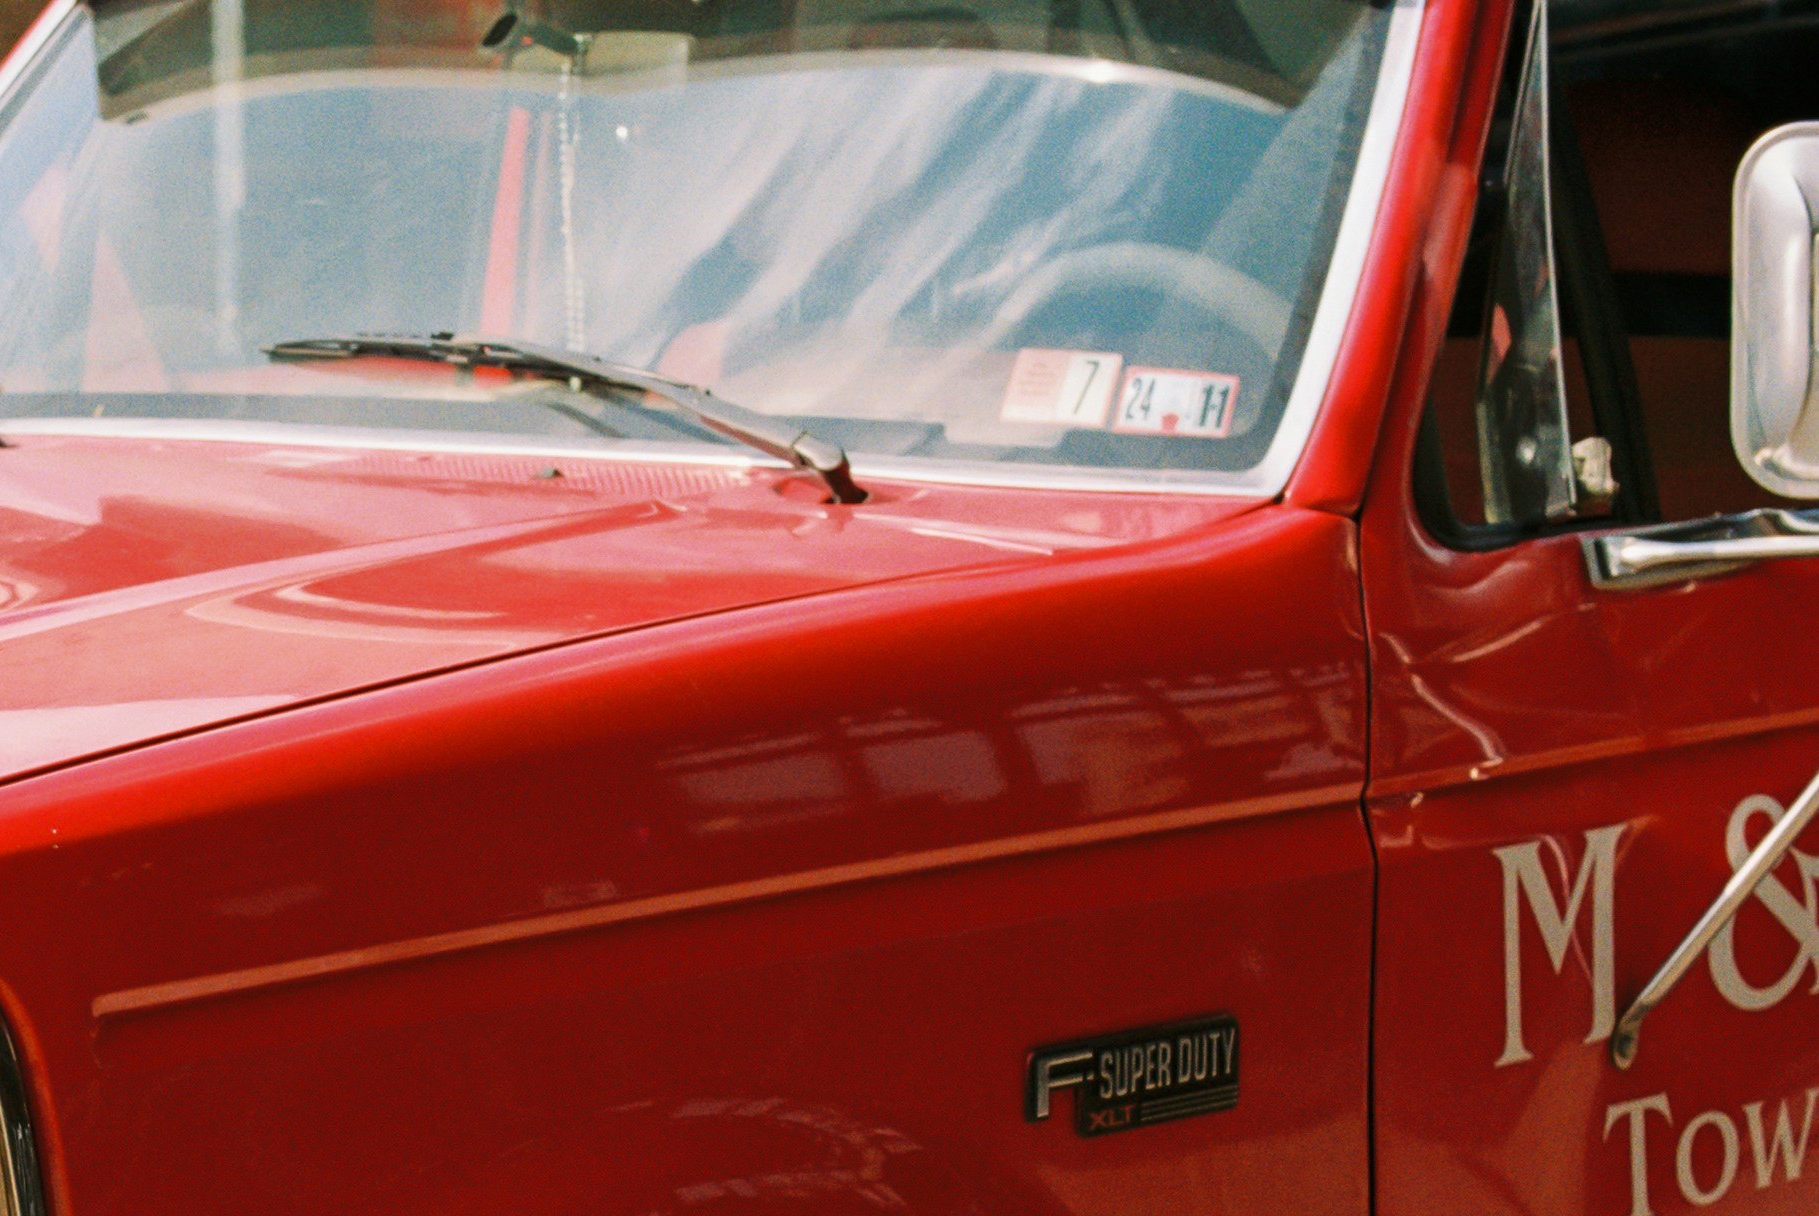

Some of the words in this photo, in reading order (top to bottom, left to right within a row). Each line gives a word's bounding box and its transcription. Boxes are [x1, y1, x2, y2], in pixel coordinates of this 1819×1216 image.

[1073, 360, 1100, 415] 7
[1125, 377, 1156, 421] 24
[1493, 823, 1628, 1067] M
[1708, 793, 1819, 1012] &
[1100, 1042, 1172, 1099] SUPER
[1178, 1028, 1235, 1083] DUTY
[1089, 1104, 1136, 1131] XLT
